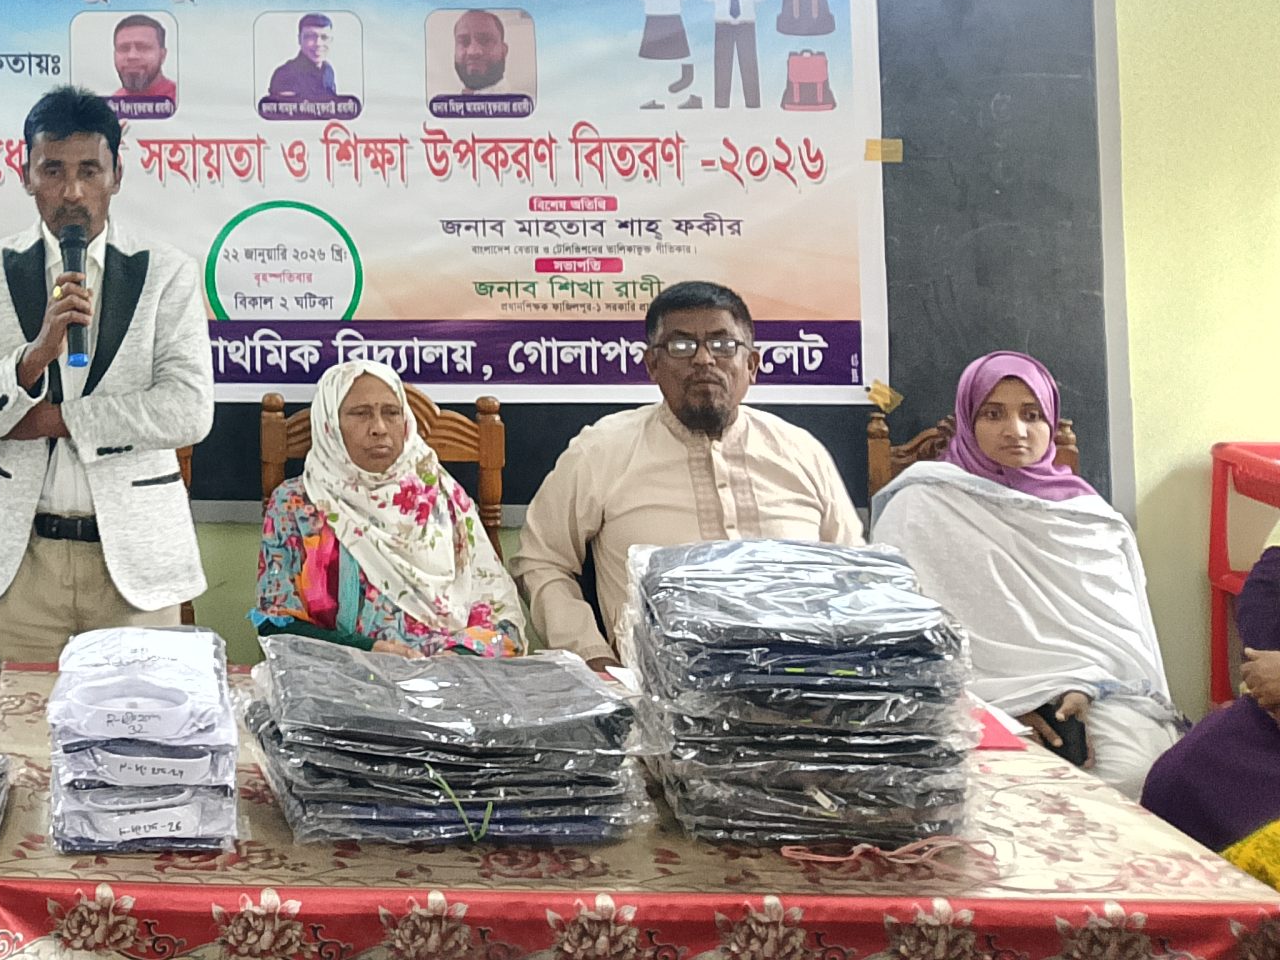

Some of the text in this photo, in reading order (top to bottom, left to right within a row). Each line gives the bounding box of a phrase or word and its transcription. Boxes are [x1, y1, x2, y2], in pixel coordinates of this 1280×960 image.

[136, 133, 267, 184] সহায়তা
[280, 139, 308, 179] ও
[320, 121, 410, 183] শিক্ষা
[420, 121, 559, 183] উপকরণ
[568, 121, 686, 183] বিতরণ
[700, 136, 827, 188] -২০২৬
[439, 217, 507, 237] জনাব
[515, 217, 607, 238] মাহতাব
[672, 211, 744, 237] ফকীর
[222, 247, 240, 263] ২২
[244, 243, 288, 265] জানুয়ারি
[292, 247, 326, 263] ২০২৬
[473, 275, 666, 299] জনাব শিখা রাণী
[234, 291, 334, 311] বিকাল ২ ঘটিকা
[210, 327, 324, 375] াথমিক
[508, 336, 648, 375] গোলাপগ
[753, 327, 829, 376] লেট
